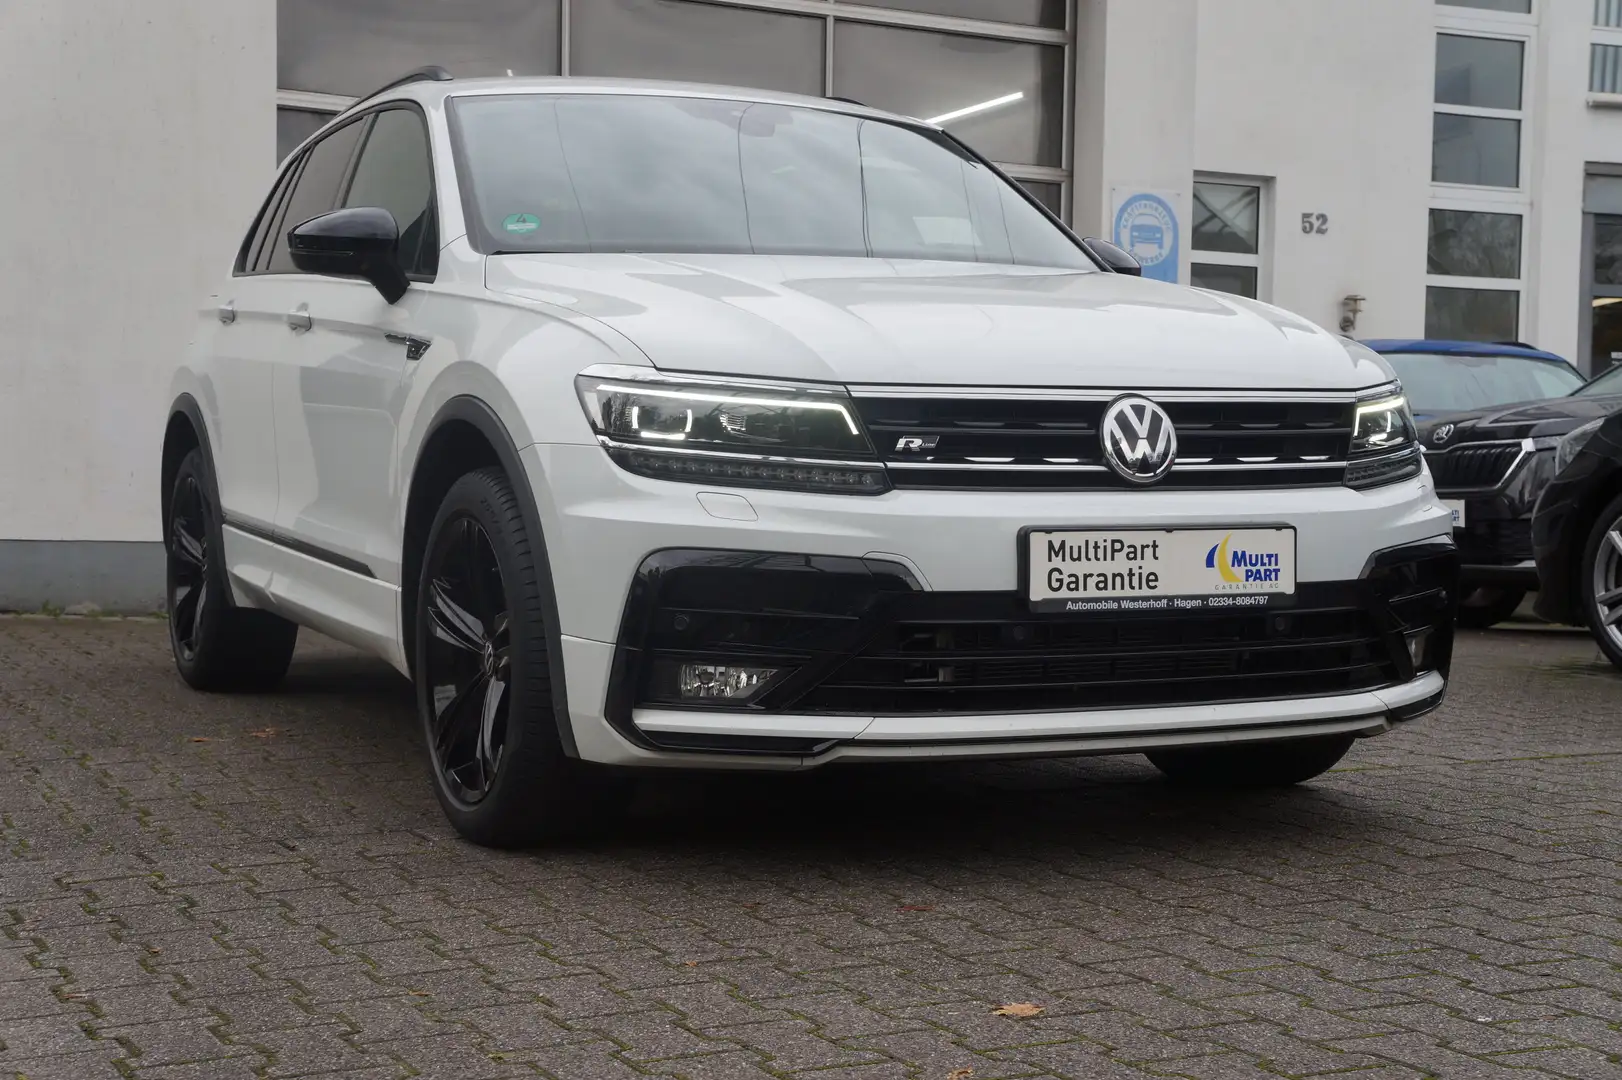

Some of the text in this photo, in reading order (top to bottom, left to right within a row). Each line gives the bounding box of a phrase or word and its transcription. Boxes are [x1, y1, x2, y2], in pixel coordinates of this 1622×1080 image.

[516, 213, 527, 224] 4
[1301, 212, 1329, 235] 52
[894, 438, 922, 451] R
[1047, 538, 1159, 562] MultiPart
[1231, 550, 1278, 568] MULTI
[1047, 565, 1159, 592] Garantie
[1244, 568, 1280, 582] PART
[1066, 595, 1268, 610] Automobile Westerhoff Hagen 02334-8084797
